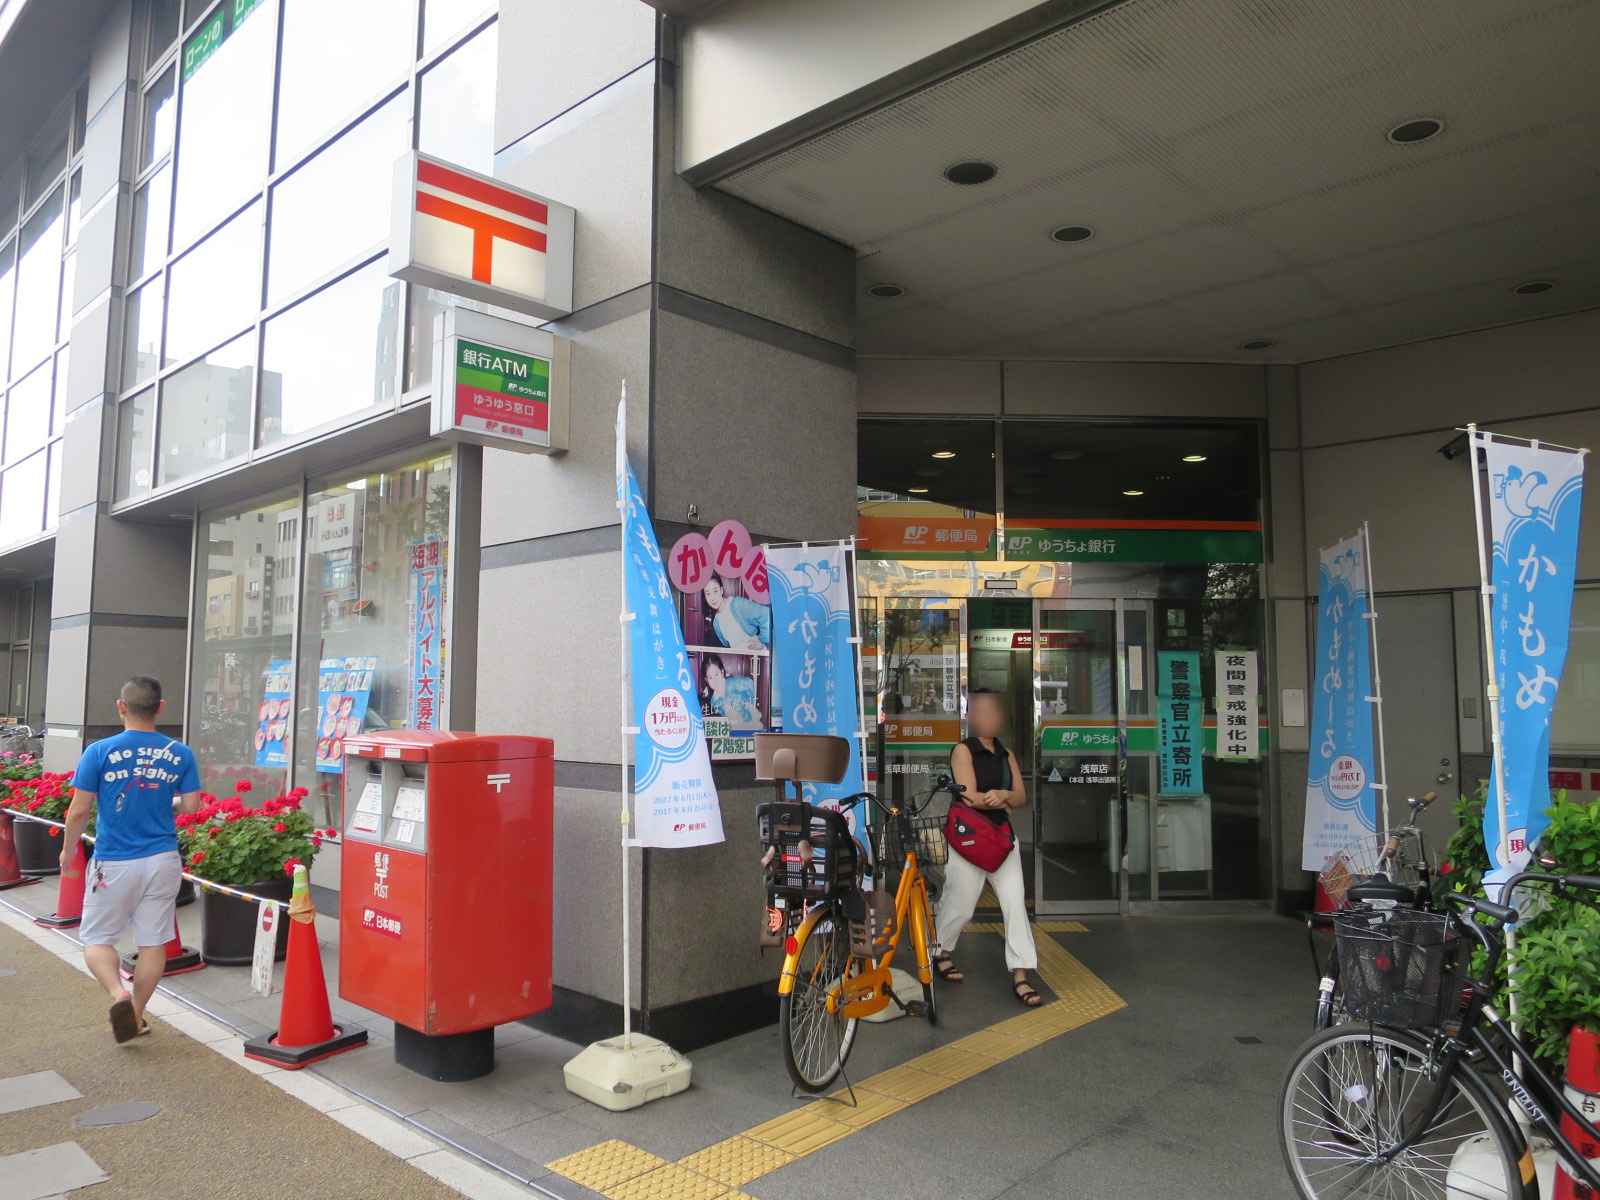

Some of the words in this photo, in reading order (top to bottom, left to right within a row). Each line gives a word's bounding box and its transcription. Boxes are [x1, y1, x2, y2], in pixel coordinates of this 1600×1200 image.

[185, 20, 221, 70] ローンの
[462, 348, 528, 378] 銀行ATM
[473, 393, 535, 417] ゆうゆう窓口
[934, 528, 978, 543] 郵便局
[411, 540, 440, 570] 短期
[1038, 539, 1116, 554] ゆうちょ銀行
[661, 696, 679, 709] 現金
[1225, 655, 1248, 755] 夜間警戒強化中
[702, 720, 730, 737] 談は
[902, 726, 933, 737] 郵便局
[1169, 660, 1192, 788] 警察官立寄所
[712, 737, 756, 755] 2階窓口
[107, 749, 133, 765] No
[1080, 763, 1109, 774] 浅草店
[671, 778, 702, 791] 販売期間
[688, 822, 707, 832] 郵便局
[374, 851, 390, 871] 郵便
[373, 882, 389, 900] POST
[376, 914, 402, 935] 日本郵便
